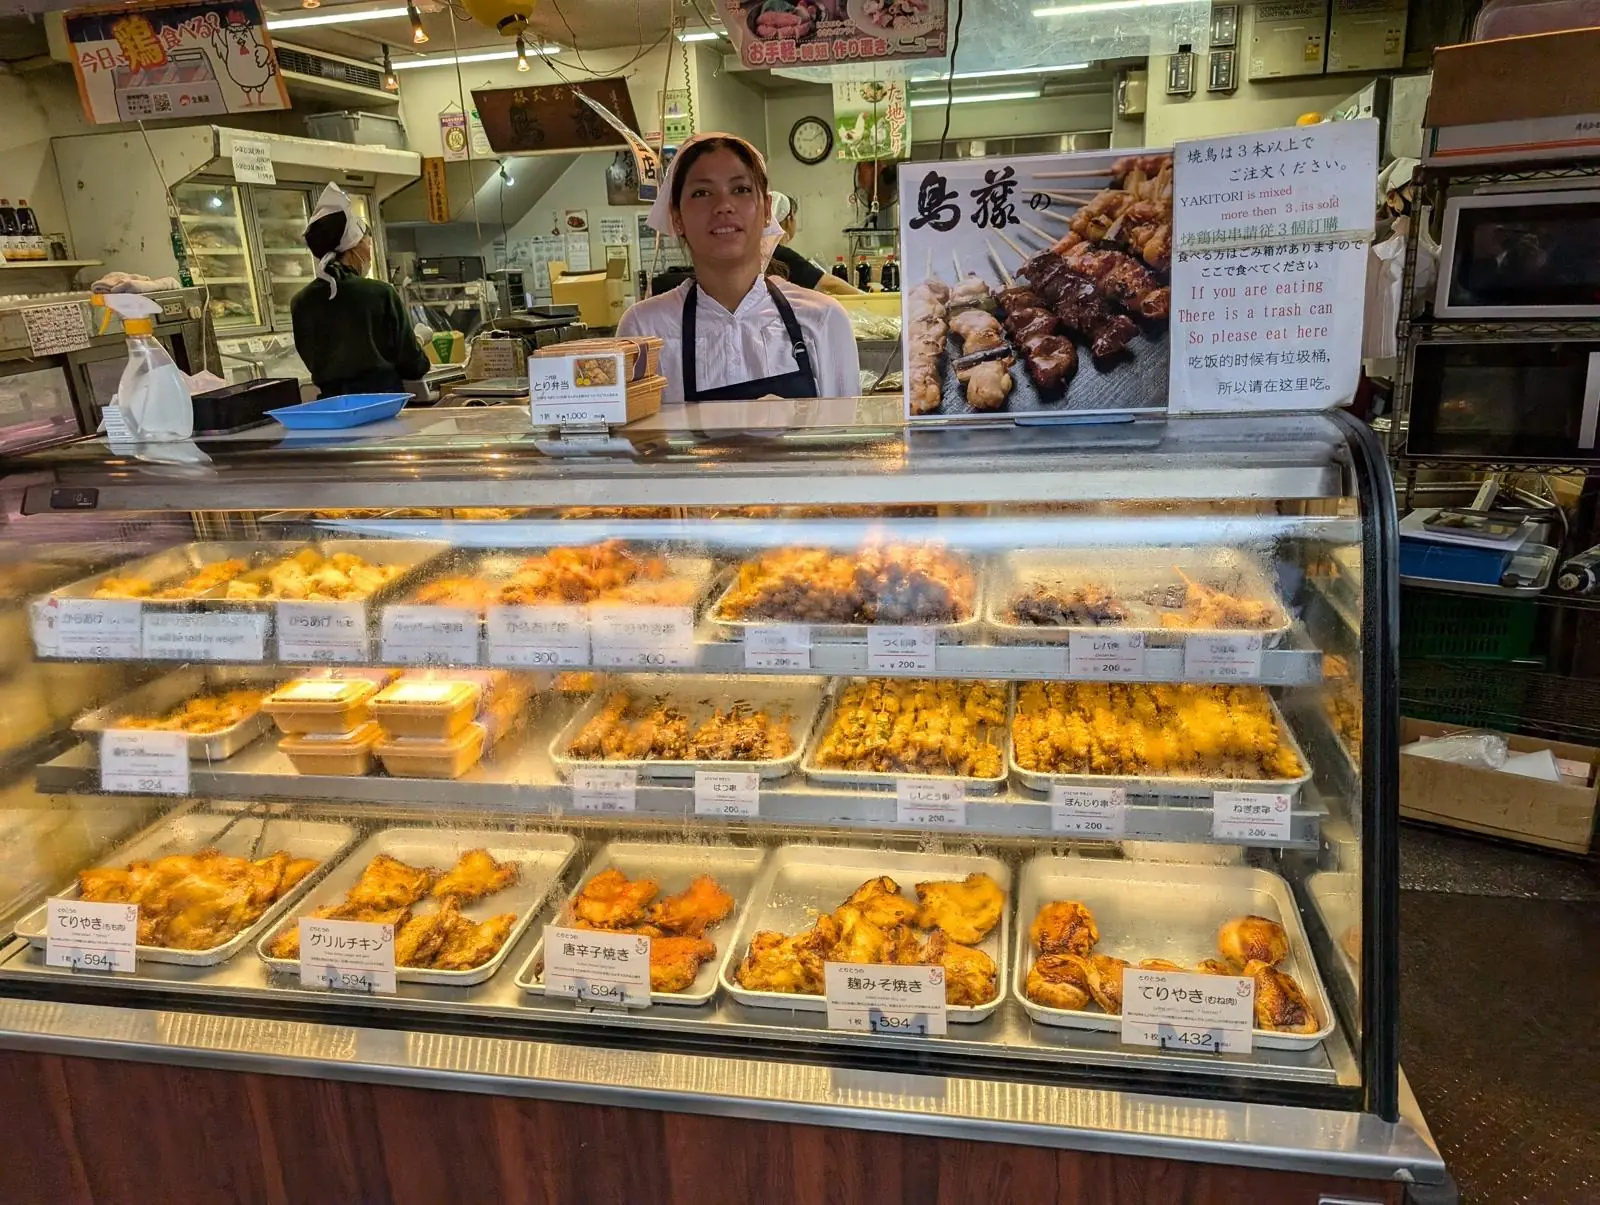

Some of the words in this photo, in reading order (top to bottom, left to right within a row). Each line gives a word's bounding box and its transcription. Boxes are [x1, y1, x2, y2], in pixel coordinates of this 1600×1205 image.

[1228, 161, 1348, 182] ご注文ください。
[1180, 190, 1244, 212] YAKITORI
[1247, 189, 1256, 200] is
[1259, 186, 1293, 199] mixed
[1221, 208, 1250, 221] more
[1252, 205, 1277, 218] then
[1301, 201, 1315, 213] its
[1318, 196, 1341, 211] sold
[1201, 260, 1319, 278] ここで食べてください
[1191, 286, 1205, 300] If
[1213, 288, 1236, 302] you
[1244, 286, 1268, 297] are
[1276, 280, 1324, 298] eating
[1178, 308, 1216, 322] There
[1226, 307, 1239, 319] is
[1247, 310, 1255, 320] a
[1264, 304, 1302, 318] trash
[1309, 304, 1334, 316] can
[1188, 331, 1205, 345] So
[1212, 328, 1258, 347] please
[1266, 327, 1288, 340] eat
[1297, 325, 1329, 340] here
[534, 380, 569, 391] とり弁当
[1217, 377, 1331, 395] 所以请在这里吃。
[533, 652, 559, 664] 300
[898, 661, 915, 669] 200
[1102, 664, 1120, 672] 200
[723, 805, 739, 814] 200
[928, 815, 945, 823] 200
[1085, 822, 1103, 830] 200
[1247, 828, 1266, 837] 200
[310, 934, 383, 951] グリルチキン
[84, 954, 107, 965] 594
[563, 943, 630, 962] 唐辛子焼き
[342, 974, 368, 986] 594
[847, 977, 922, 993] 麹みそ焼き
[591, 984, 618, 997] 594
[879, 1016, 911, 1028] 594
[1178, 1032, 1212, 1047] 432
